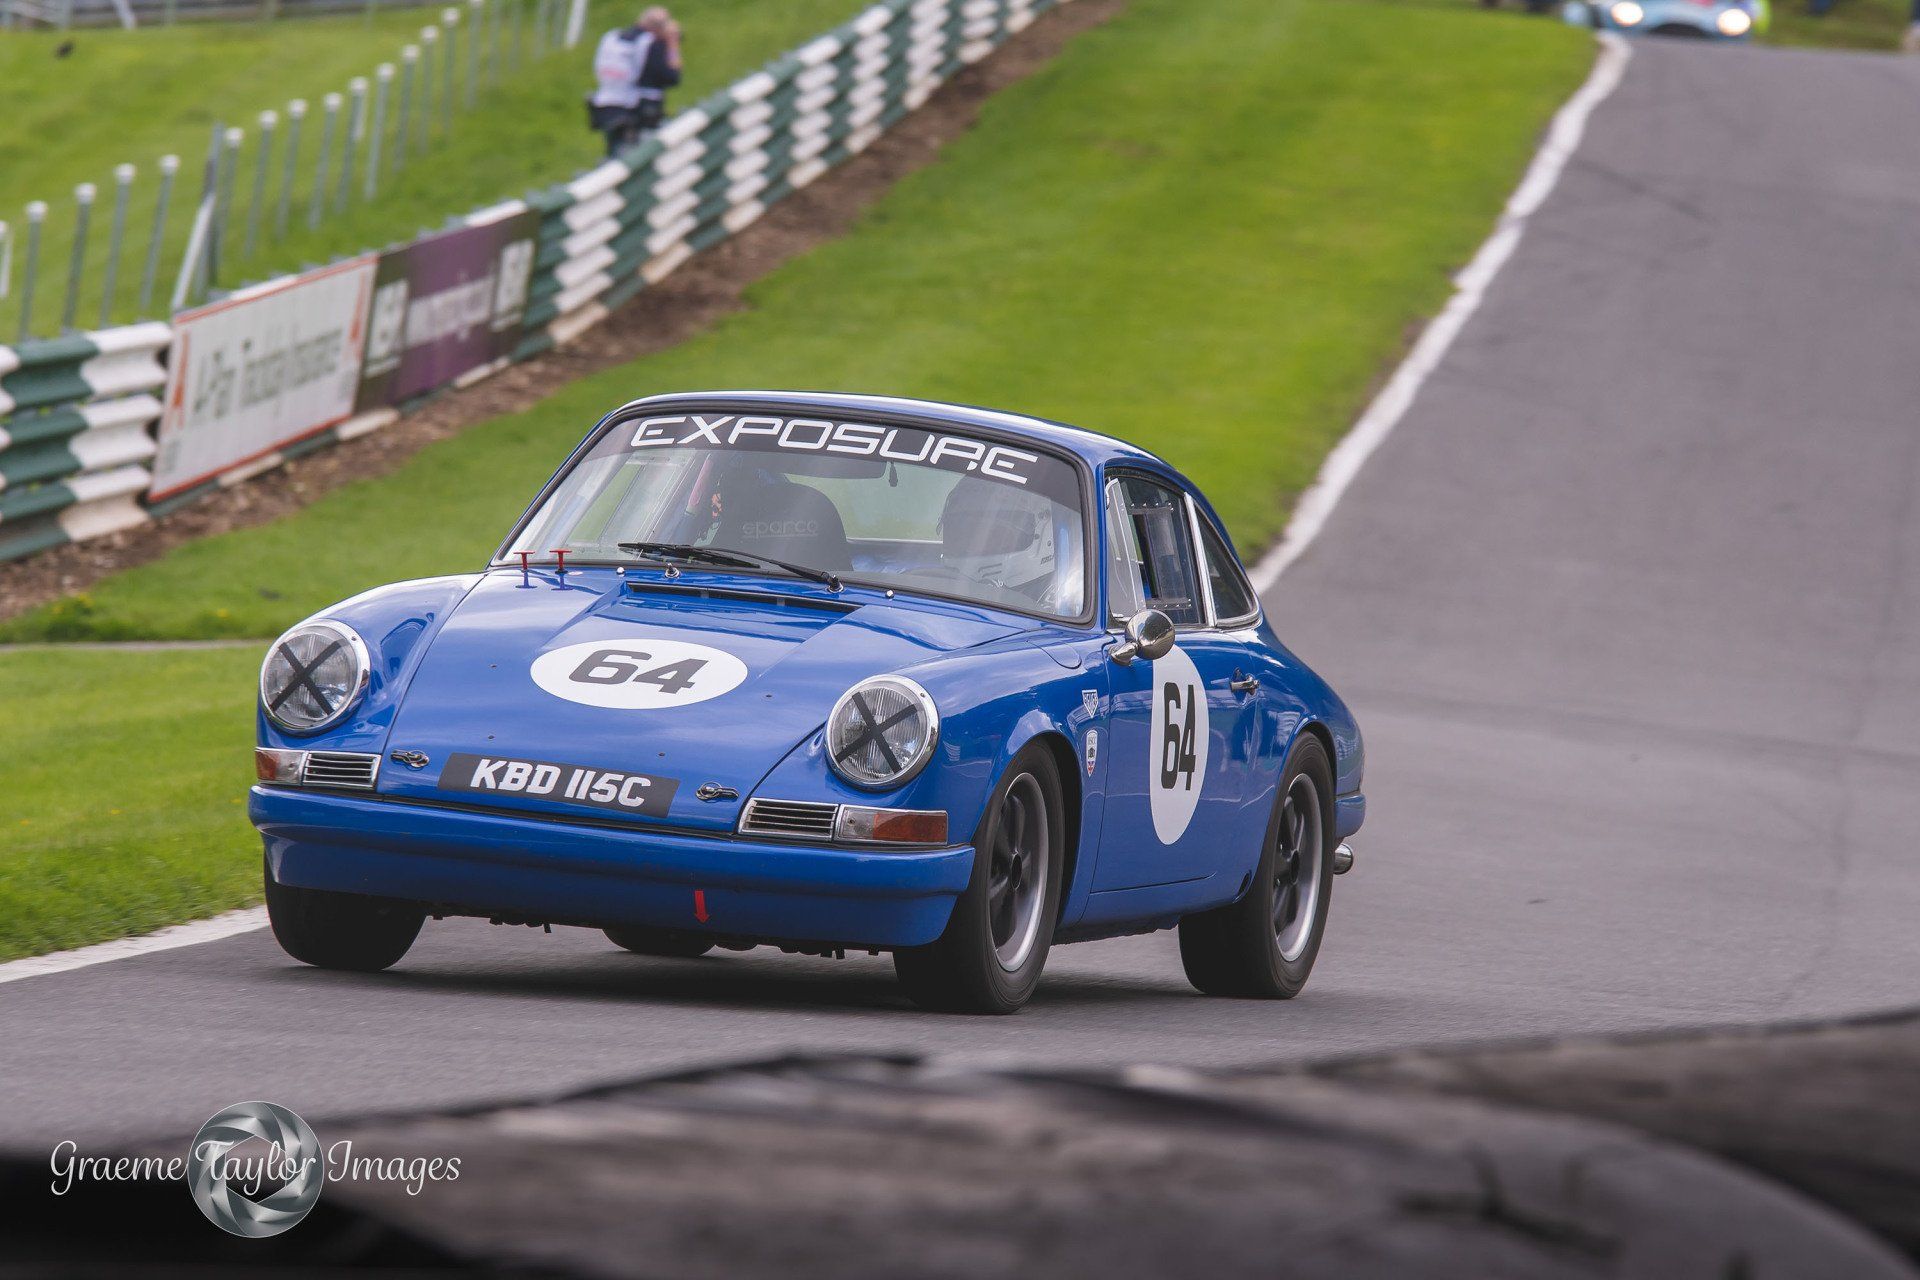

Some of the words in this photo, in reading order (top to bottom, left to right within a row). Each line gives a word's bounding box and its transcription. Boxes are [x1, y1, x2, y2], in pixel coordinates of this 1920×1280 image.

[630, 416, 1038, 484] EXPOSURE
[742, 519, 818, 539] sparco
[568, 649, 709, 694] 64
[1161, 682, 1196, 791] 64
[470, 758, 561, 795] KBD
[564, 769, 651, 807] 115C
